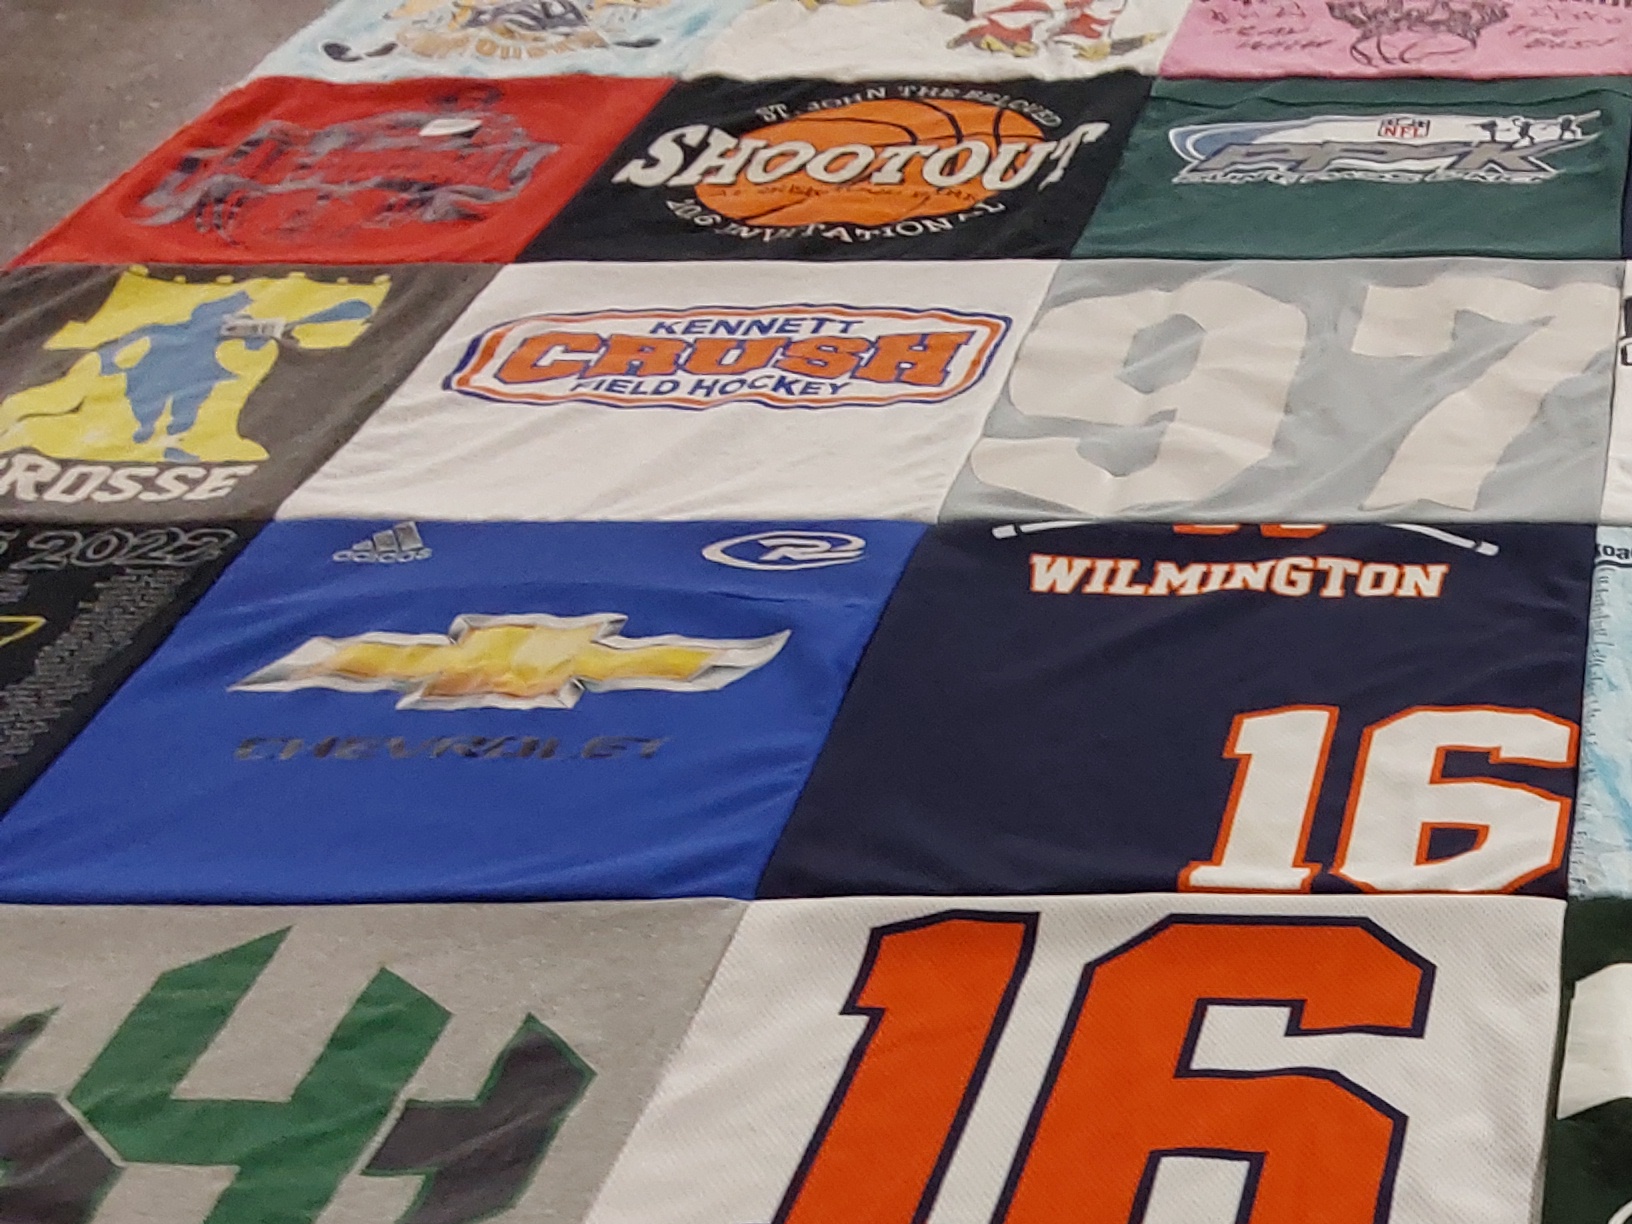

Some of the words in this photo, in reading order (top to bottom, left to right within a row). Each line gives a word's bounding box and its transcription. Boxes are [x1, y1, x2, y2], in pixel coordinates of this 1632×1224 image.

[613, 122, 1110, 191] SHOOTOUT
[650, 317, 864, 336] KENNETT
[494, 331, 977, 386] CRUSH
[570, 379, 678, 396] FIELD
[684, 374, 853, 397] HOCKEY
[971, 278, 1620, 517] 97
[0, 453, 258, 502] ROSSE
[1029, 552, 1449, 599] WILMINGTON
[234, 735, 675, 761] CHEVROLET
[1176, 704, 1580, 896] 16
